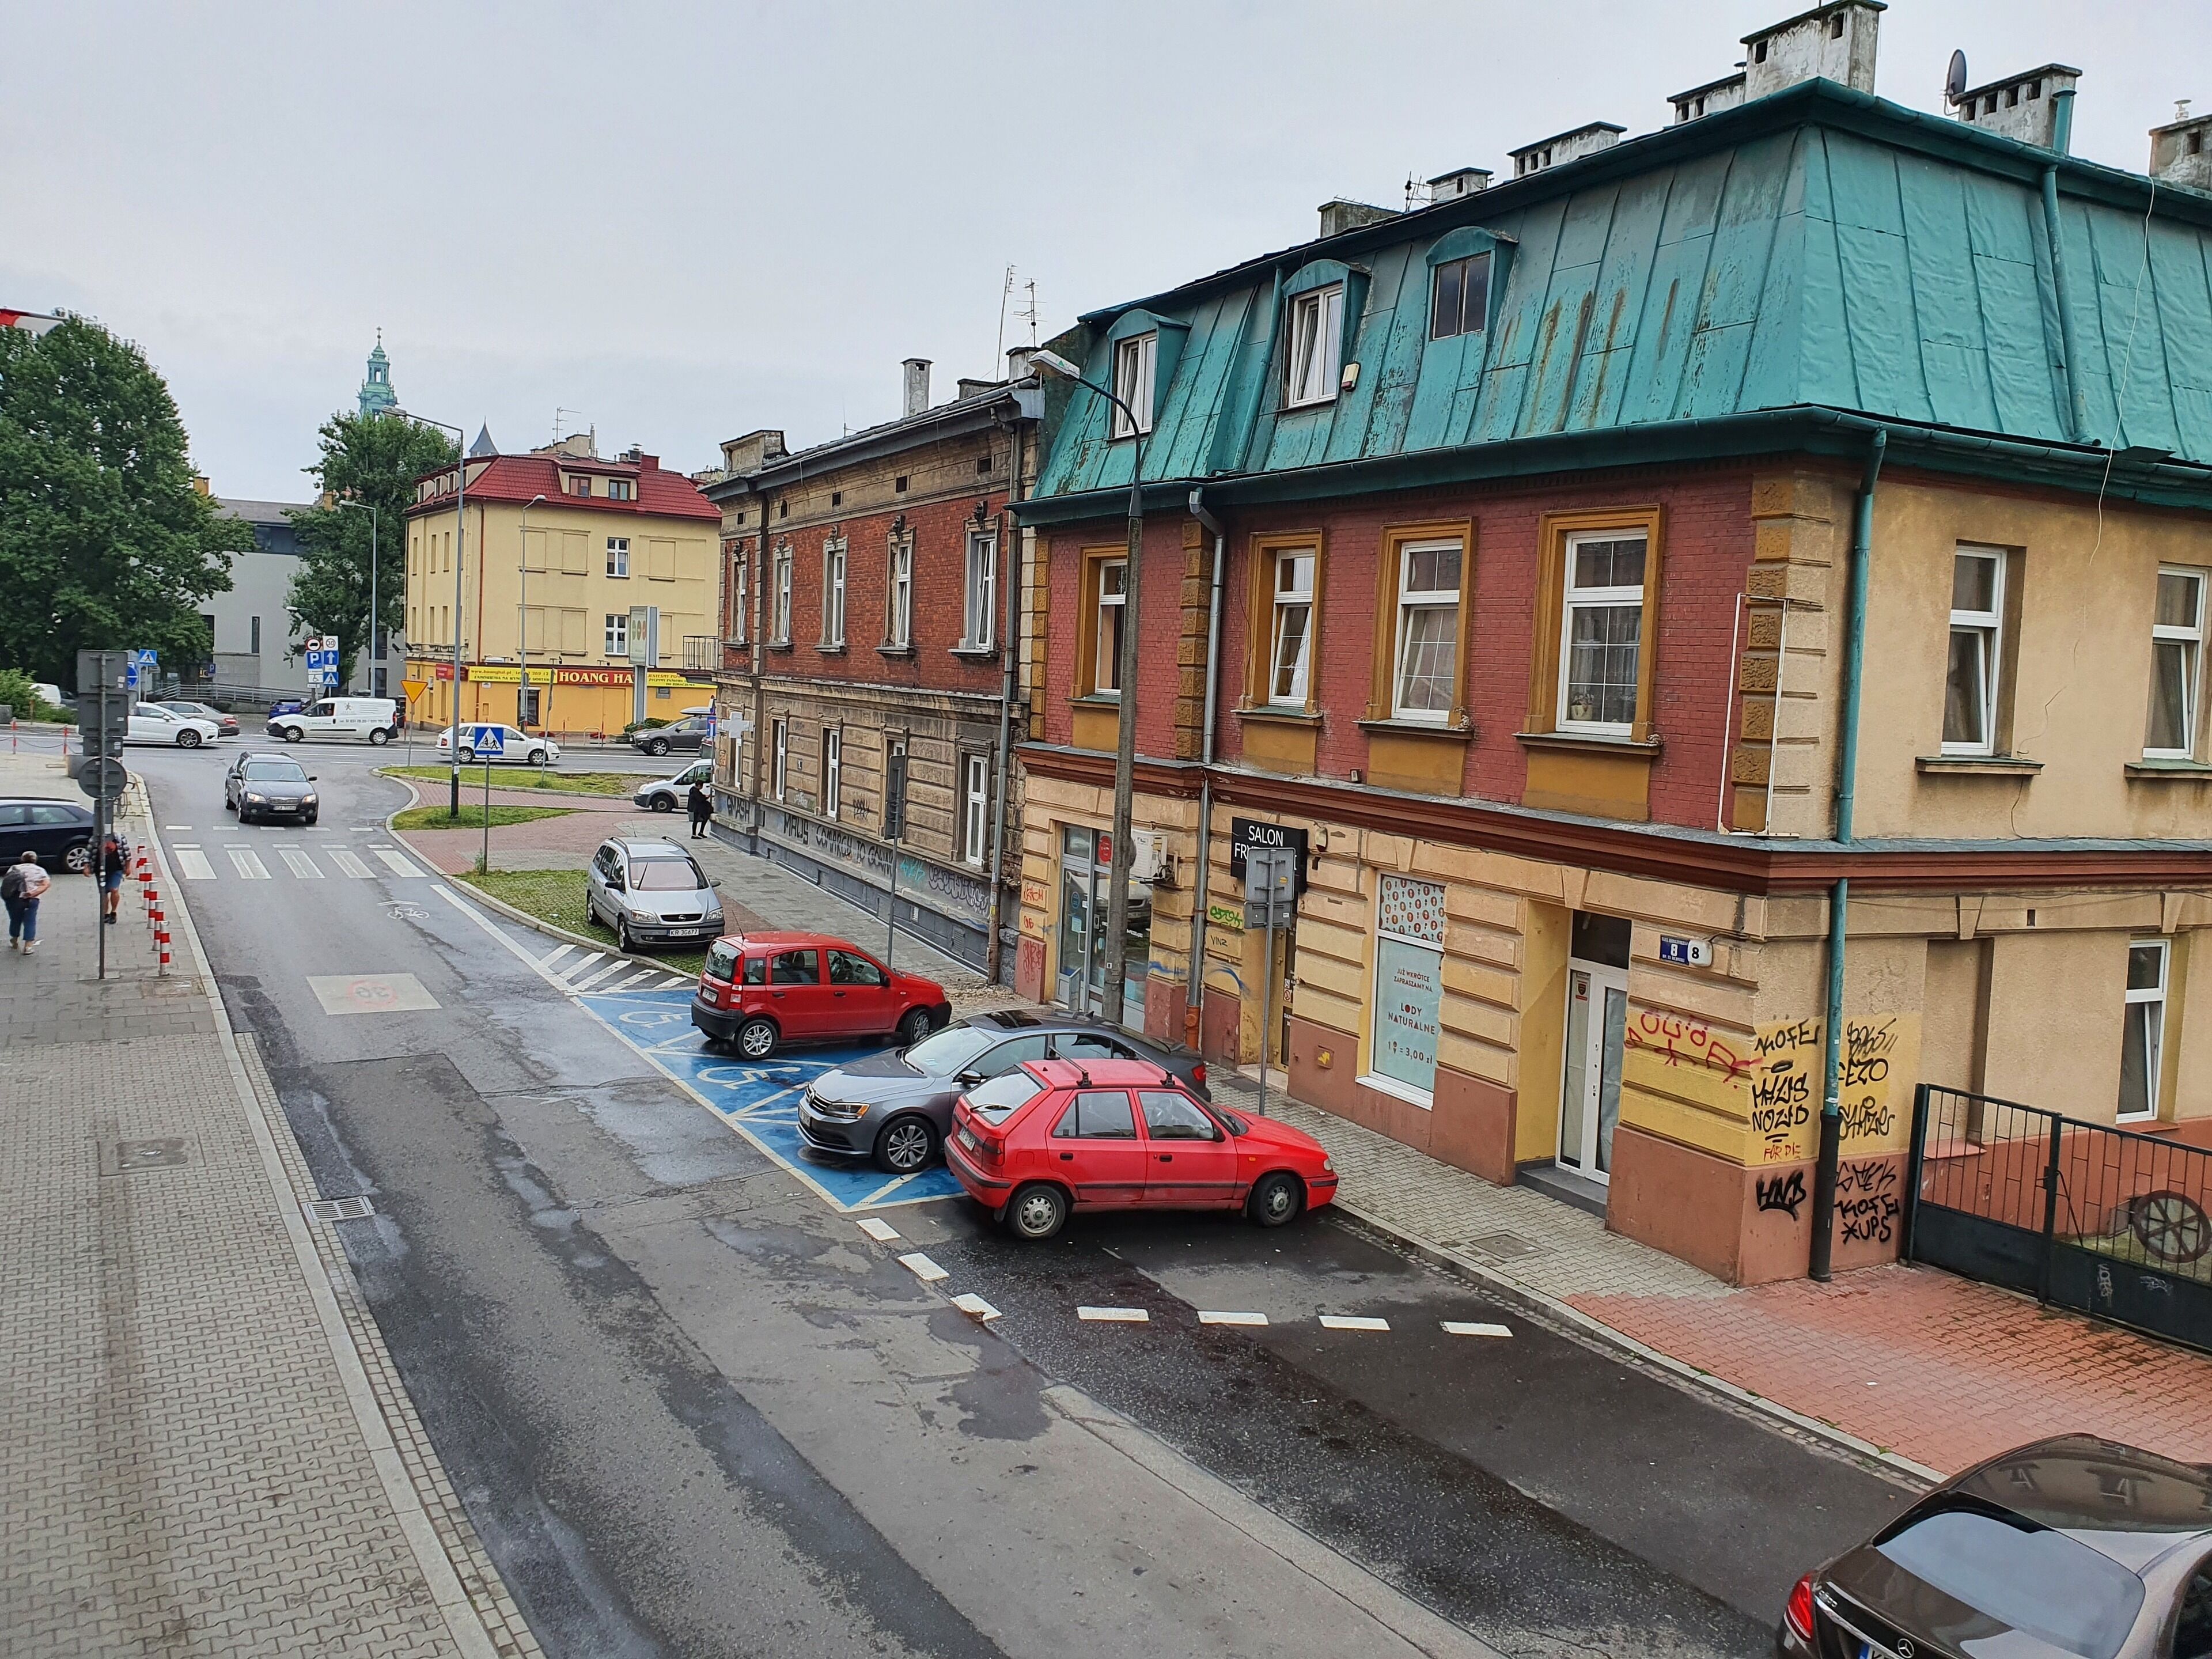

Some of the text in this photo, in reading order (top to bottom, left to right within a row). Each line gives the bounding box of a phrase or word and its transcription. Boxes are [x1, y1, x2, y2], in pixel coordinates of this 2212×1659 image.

[310, 653, 319, 664] P
[559, 672, 609, 683] HOANG
[1248, 825, 1283, 847] SALON
[1671, 944, 1678, 956] 8
[1692, 946, 1699, 959] 8
[1393, 976, 1425, 990] ZAPRASZAMY
[1406, 970, 1430, 983] WKRÓTCE
[1400, 1002, 1422, 1017] LODY
[1388, 1012, 1435, 1035] NATURALNE
[1406, 1047, 1424, 1061] 3,00
